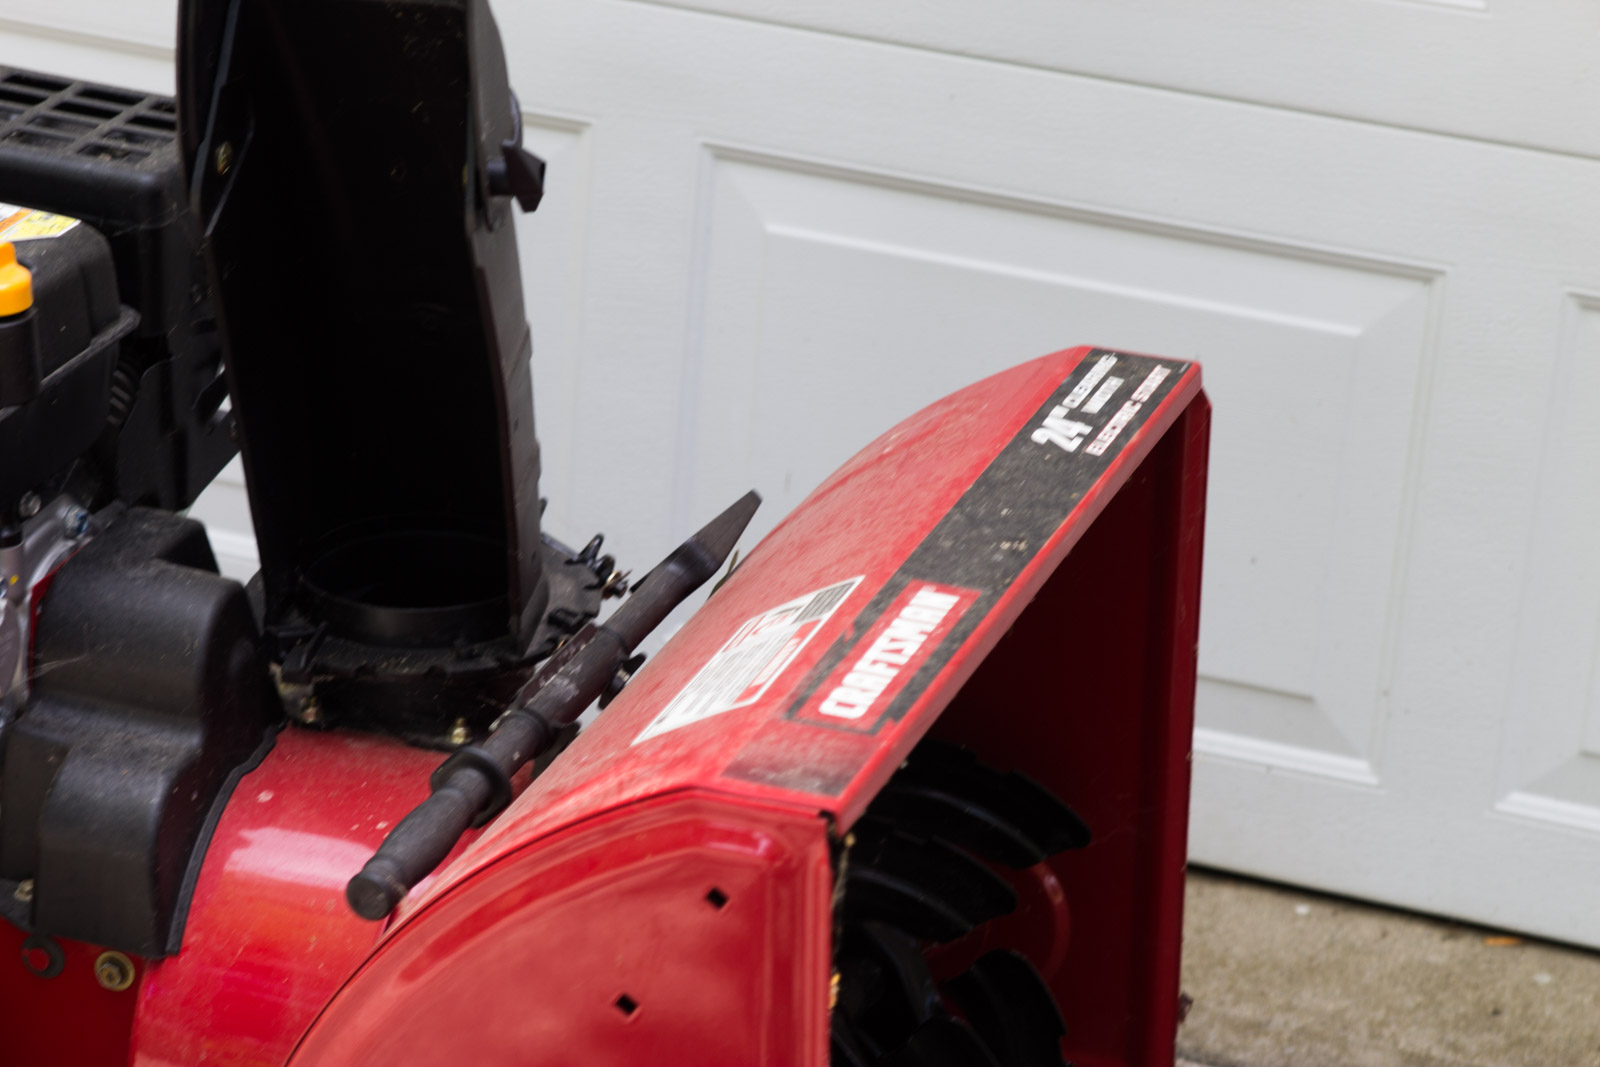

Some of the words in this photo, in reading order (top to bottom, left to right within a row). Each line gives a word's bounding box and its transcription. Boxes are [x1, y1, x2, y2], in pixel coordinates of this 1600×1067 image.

[1062, 353, 1118, 409] CLEG
[1085, 401, 1142, 456] ELECC
[818, 589, 960, 719] CRAFTSMAN
